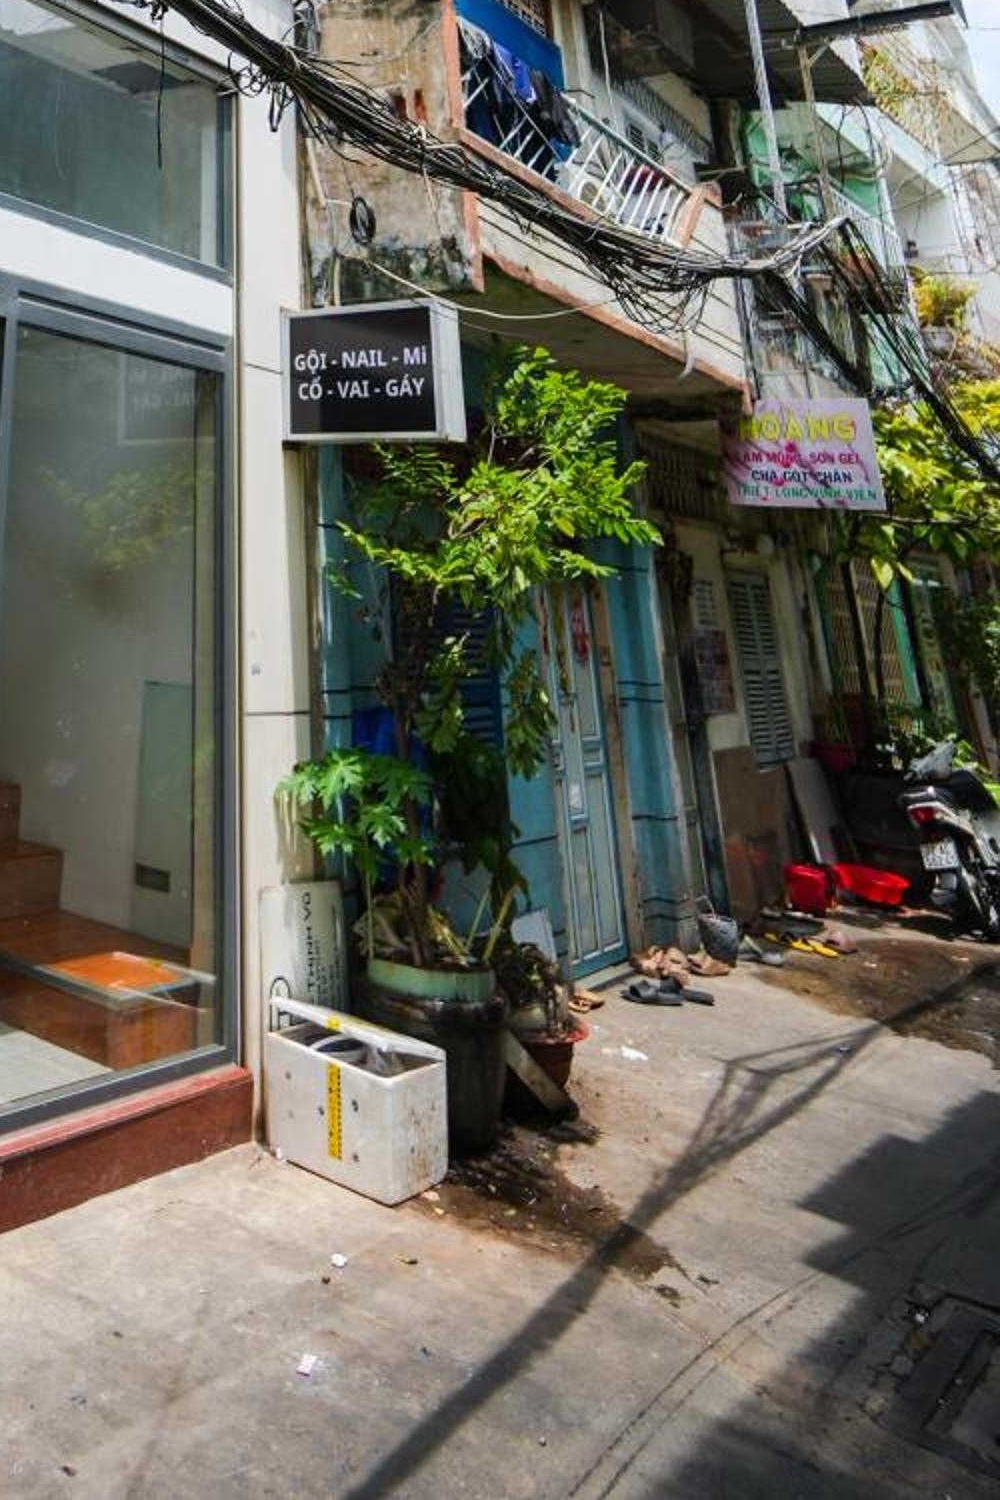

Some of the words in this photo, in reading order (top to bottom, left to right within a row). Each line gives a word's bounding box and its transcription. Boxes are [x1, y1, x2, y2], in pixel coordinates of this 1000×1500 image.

[294, 349, 327, 374] GỘI
[341, 350, 387, 369] NAIL
[337, 380, 369, 398] VAI
[386, 374, 424, 397] GÁY
